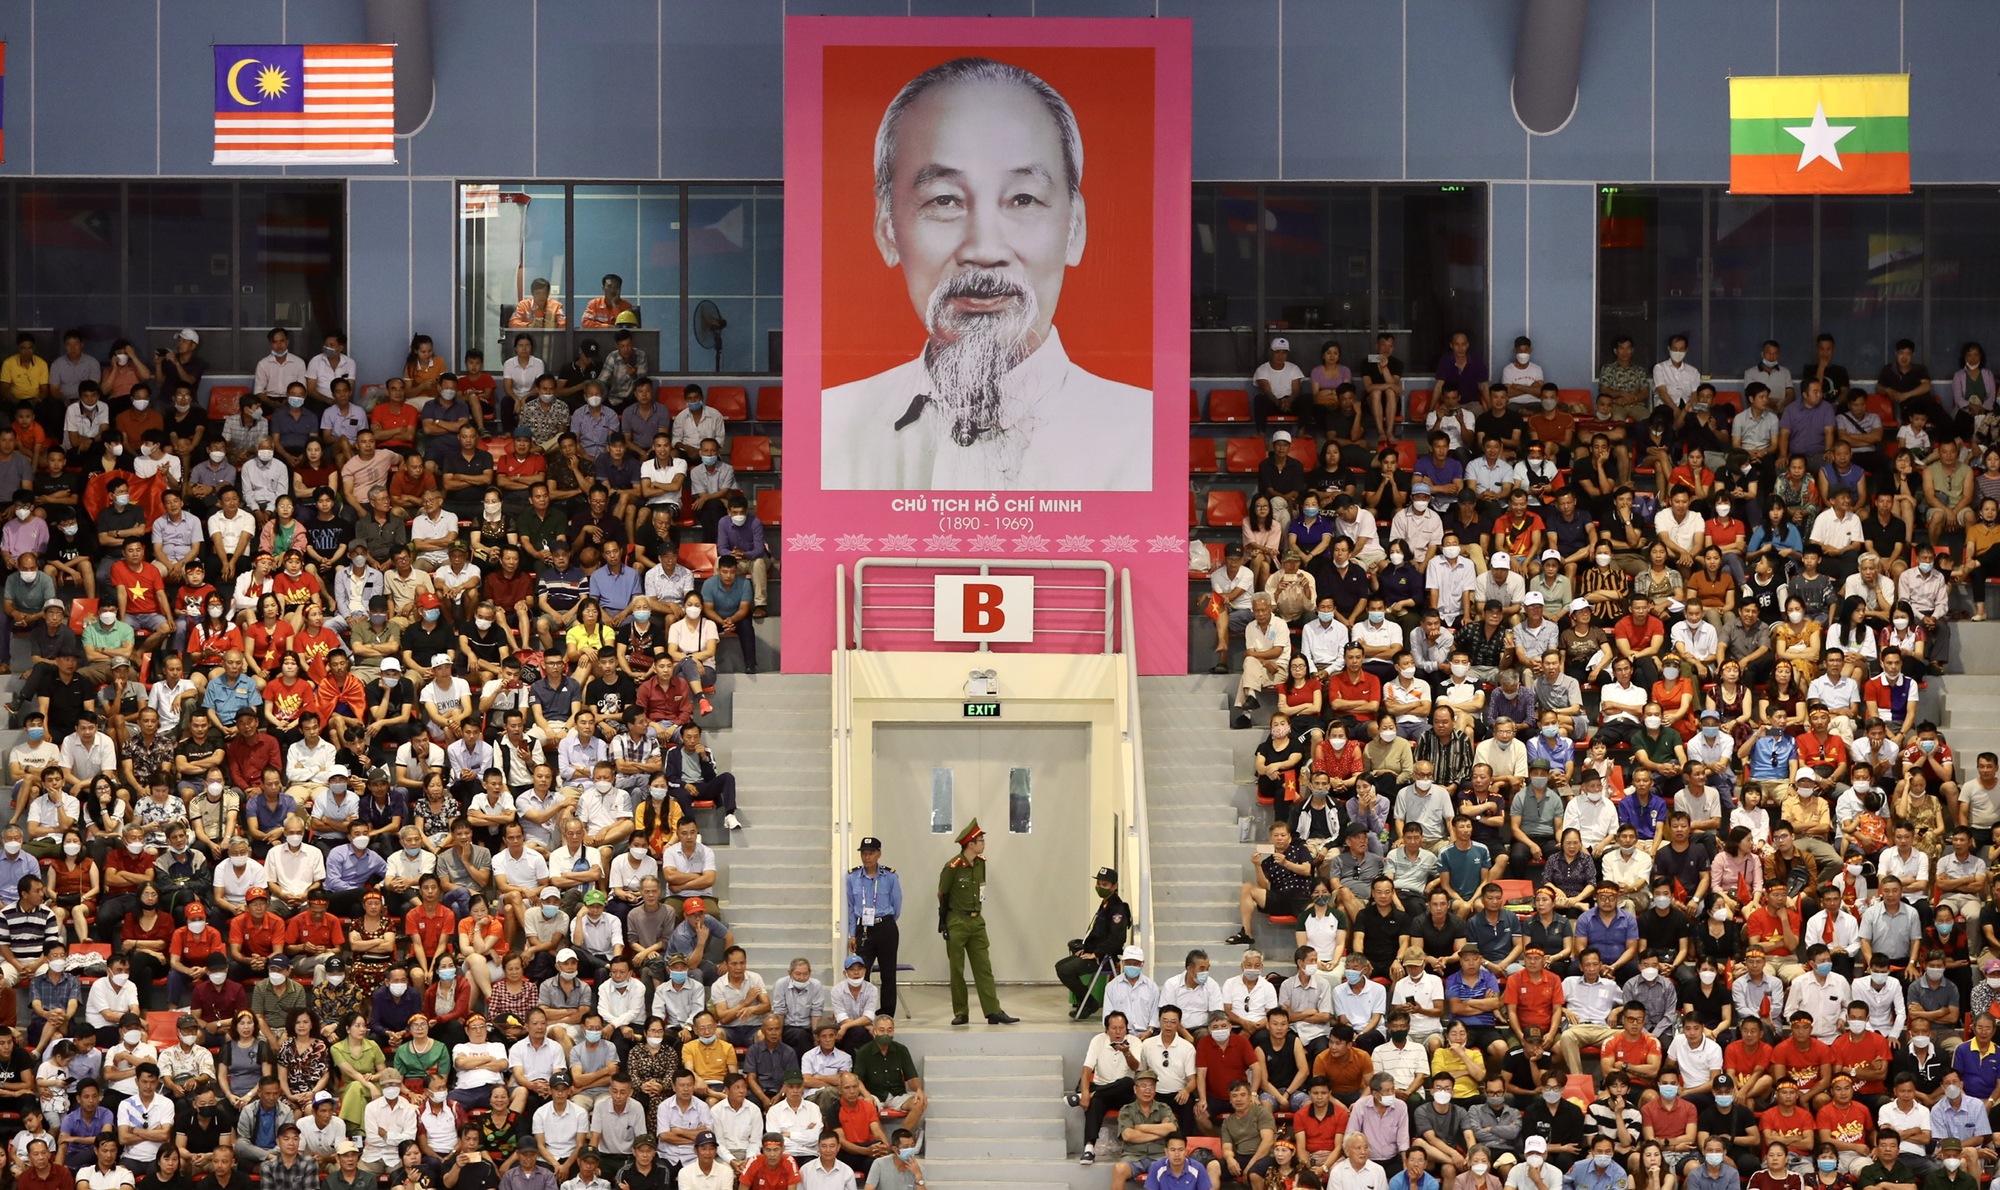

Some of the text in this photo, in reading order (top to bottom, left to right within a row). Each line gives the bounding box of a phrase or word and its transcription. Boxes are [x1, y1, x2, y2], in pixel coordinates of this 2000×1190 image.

[891, 493, 1082, 515] CHỦ TỊCH HỒ CHÍ MINH
[939, 517, 980, 532] (1890
[995, 517, 1034, 532] 1969)
[963, 584, 1005, 633] B
[968, 704, 996, 716] EXIT
